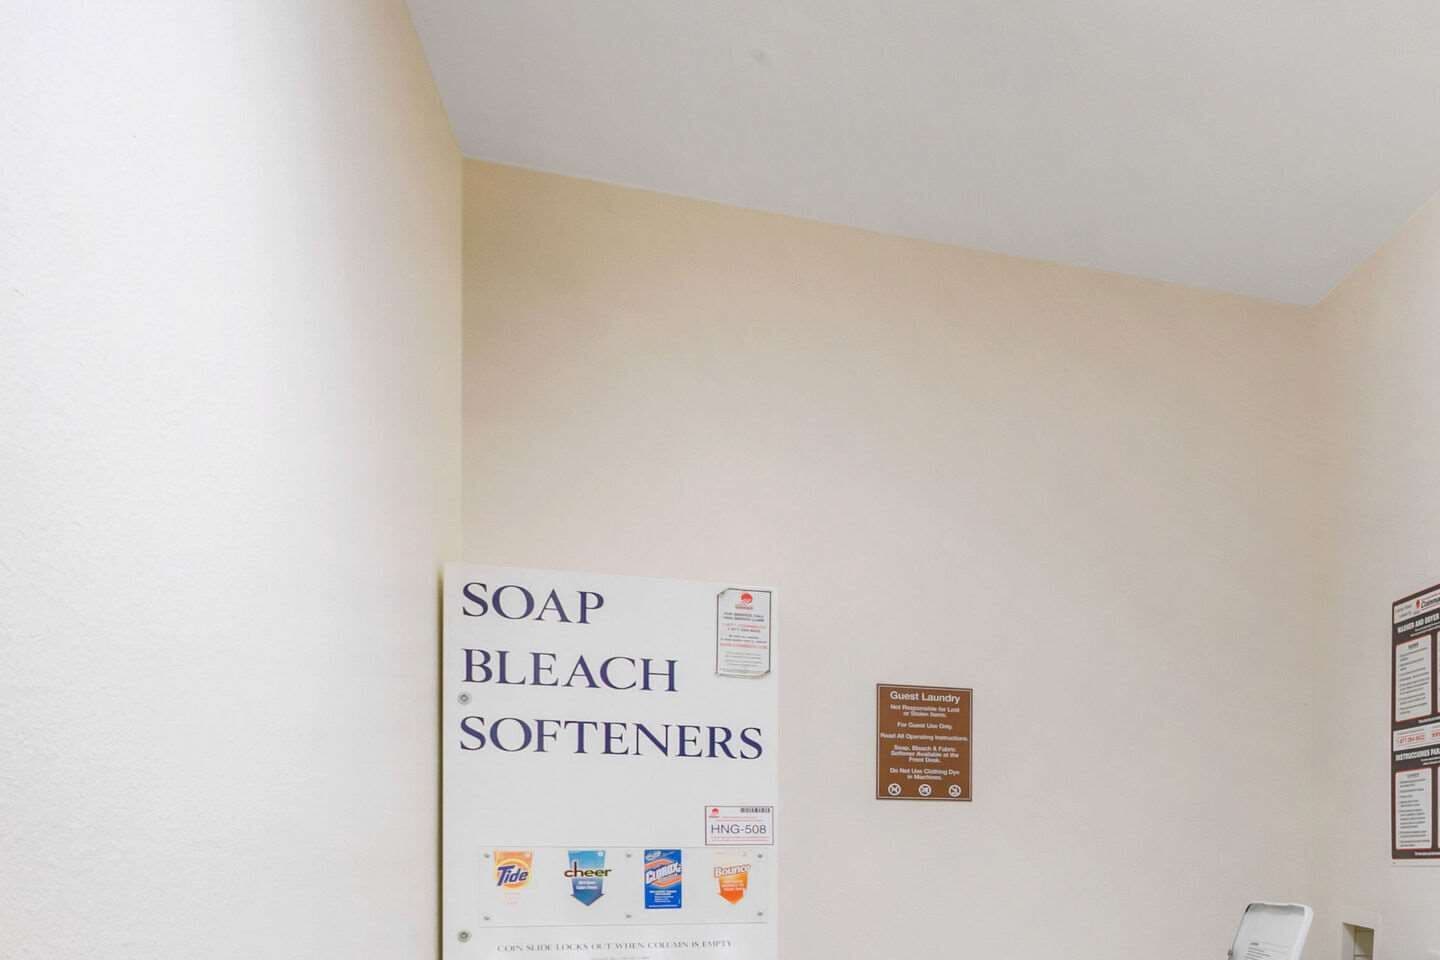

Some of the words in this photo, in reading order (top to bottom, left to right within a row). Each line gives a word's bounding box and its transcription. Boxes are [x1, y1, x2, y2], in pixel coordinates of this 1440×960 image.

[462, 581, 604, 625] SOAP
[1415, 618, 1425, 627] AND
[1425, 612, 1440, 625] DRYER
[461, 648, 679, 692] BLEACH
[889, 690, 919, 701] Guest
[921, 692, 961, 704] Laundry
[460, 715, 763, 760] SOFTENERS
[905, 733, 934, 741] Operating
[711, 823, 767, 834] HNG-508
[497, 864, 529, 887] Tide
[564, 861, 612, 878] cheer
[714, 863, 752, 878] Bounce
[496, 943, 522, 953] COIN
[525, 943, 550, 952] SLIDE
[556, 942, 589, 952] LOCKS
[591, 942, 611, 951] OUT
[615, 942, 645, 951] WHEN
[648, 940, 689, 950] COLUMN
[691, 940, 700, 949] IS
[702, 939, 732, 949] EMPTY
